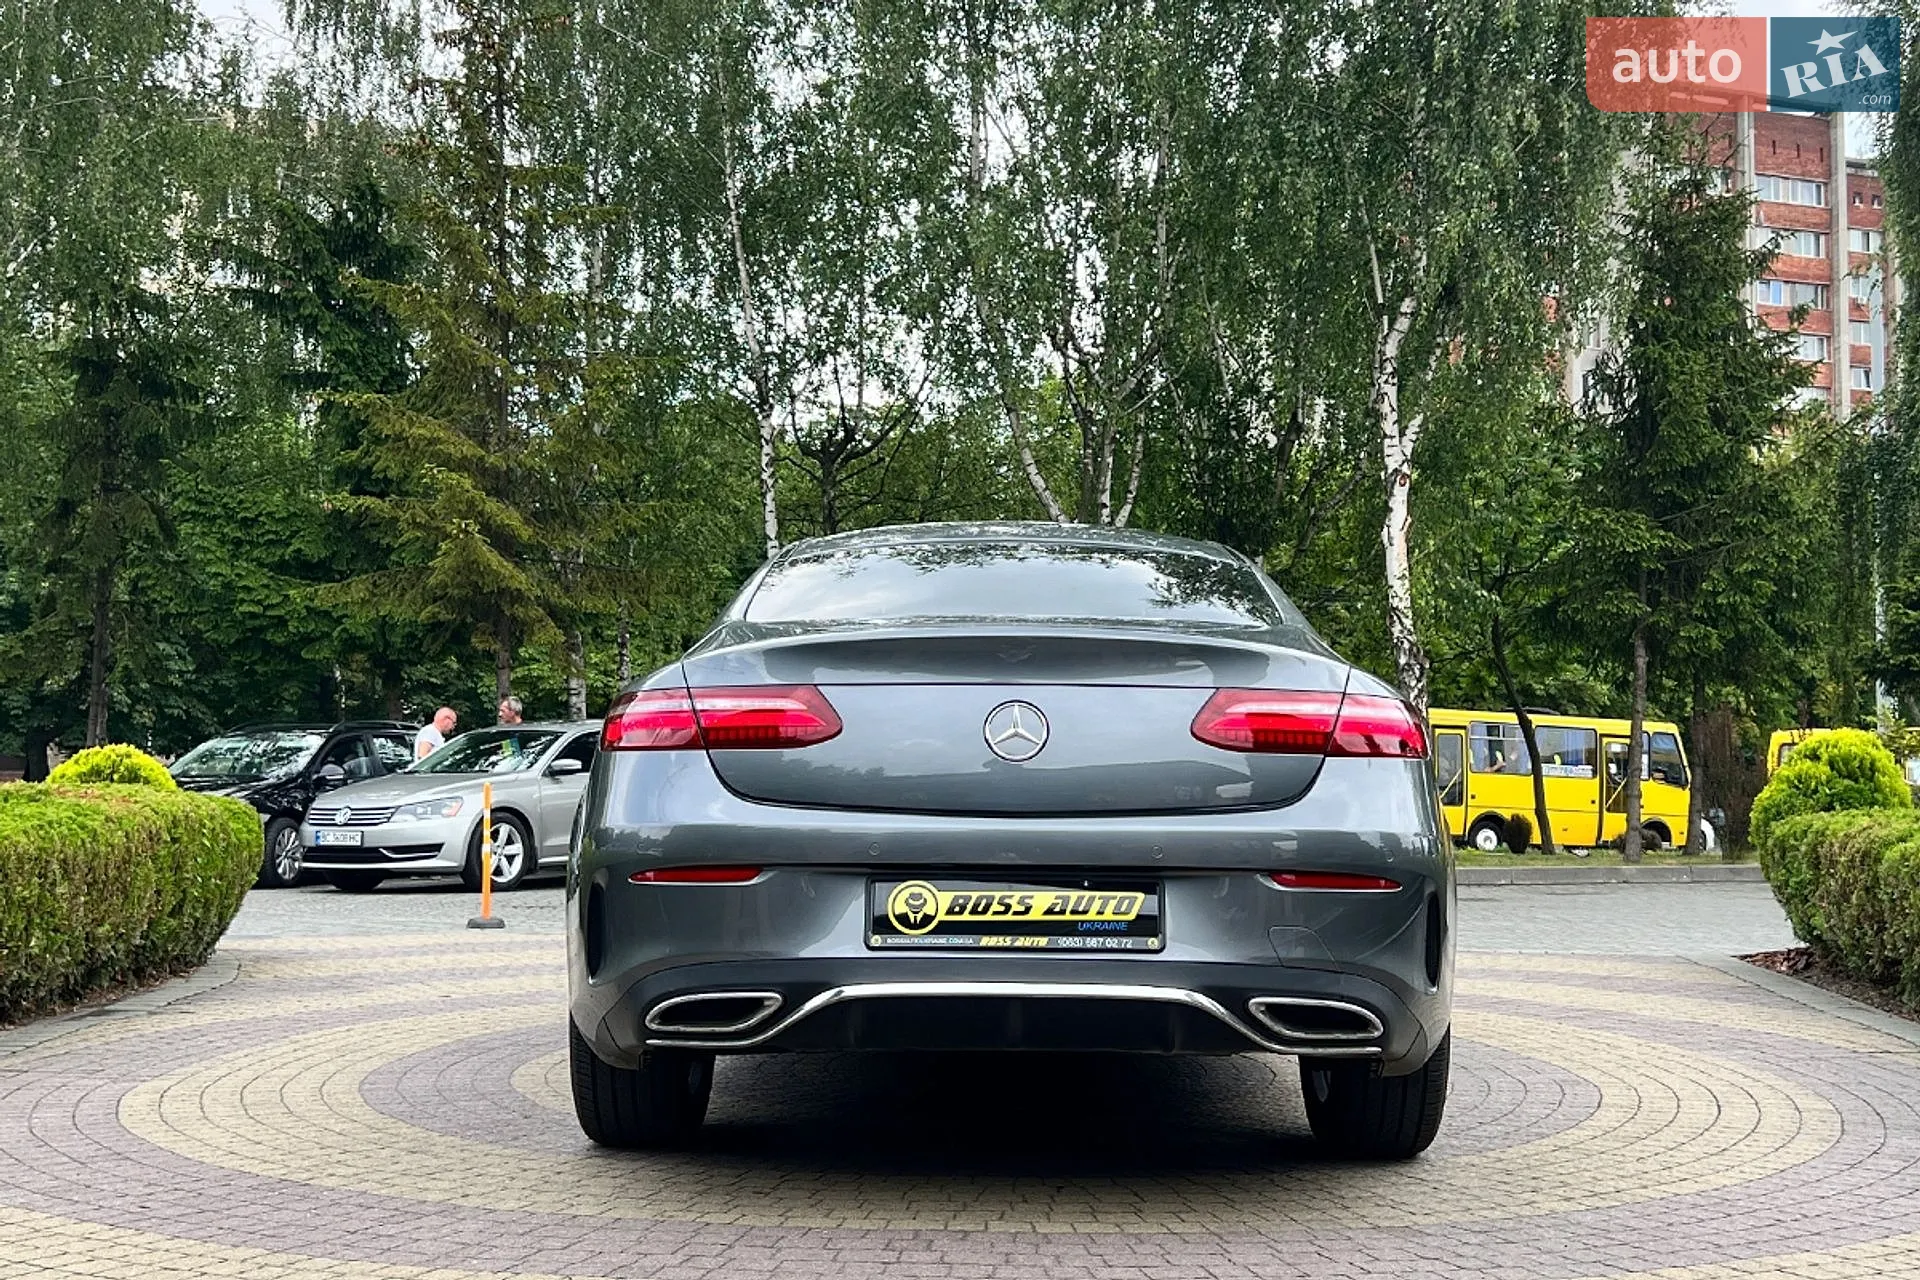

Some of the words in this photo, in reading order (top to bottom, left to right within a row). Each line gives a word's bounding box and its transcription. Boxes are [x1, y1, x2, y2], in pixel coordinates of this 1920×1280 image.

[944, 894, 1034, 916] BOSS
[1041, 894, 1139, 916] AUTO
[1077, 921, 1129, 931] UKRAINE
[979, 936, 1012, 947] BOSS
[1013, 936, 1049, 947] AUTO
